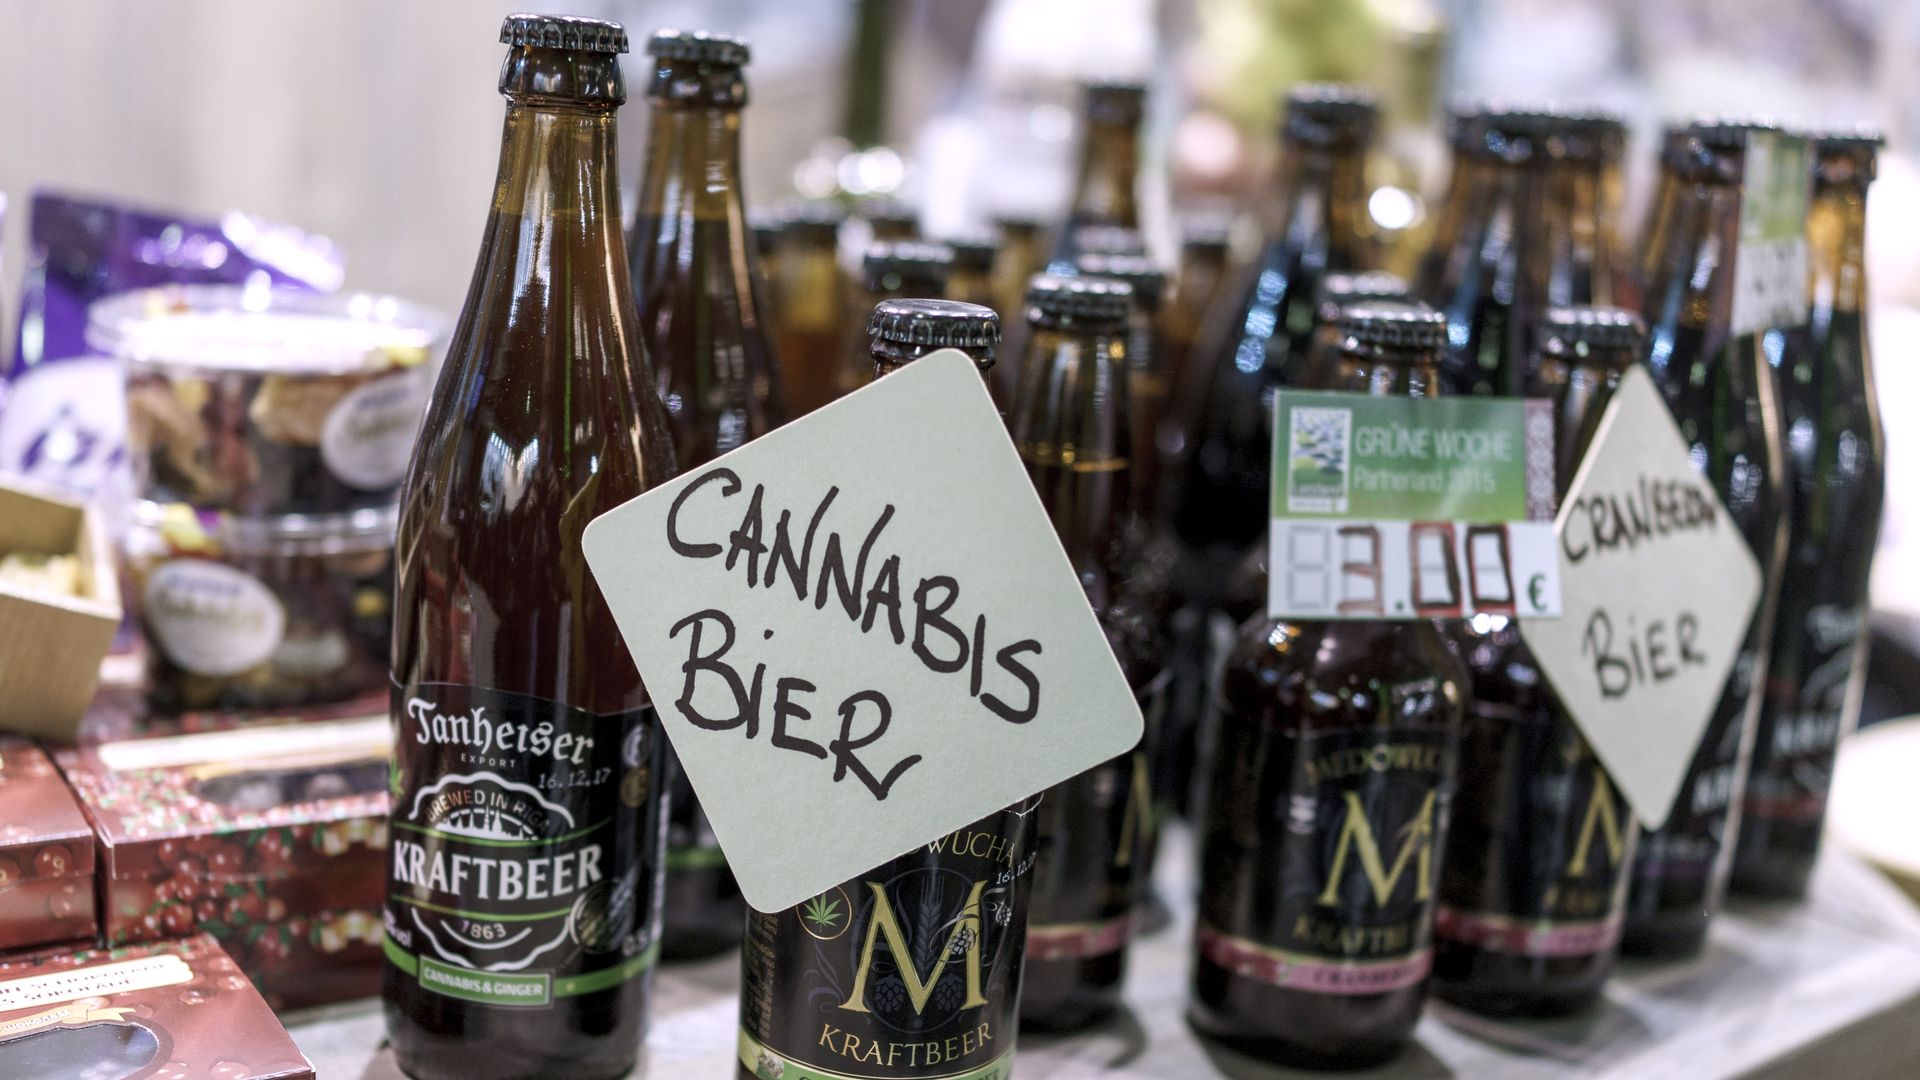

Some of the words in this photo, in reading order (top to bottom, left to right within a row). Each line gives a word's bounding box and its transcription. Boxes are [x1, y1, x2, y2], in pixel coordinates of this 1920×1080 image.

[1354, 421, 1430, 459] GRÜNE
[1434, 426, 1515, 462] WOCHE
[1448, 467, 1497, 494] 2015
[666, 467, 1043, 724] CANNABIS
[408, 697, 595, 765] Tanheiser
[461, 754, 516, 768] EXPORT
[425, 789, 485, 823] BREWED
[490, 791, 508, 810] IN
[512, 801, 550, 830] RIGA
[907, 831, 1016, 869] WUCHA
[1317, 788, 1437, 908] M
[394, 840, 603, 900] KRAFTBEER
[460, 919, 507, 941] 1863
[838, 880, 989, 1016] M
[424, 966, 480, 992] CANNABIS
[493, 982, 543, 996] GINGER
[818, 1022, 994, 1067] KRAFTBEER
